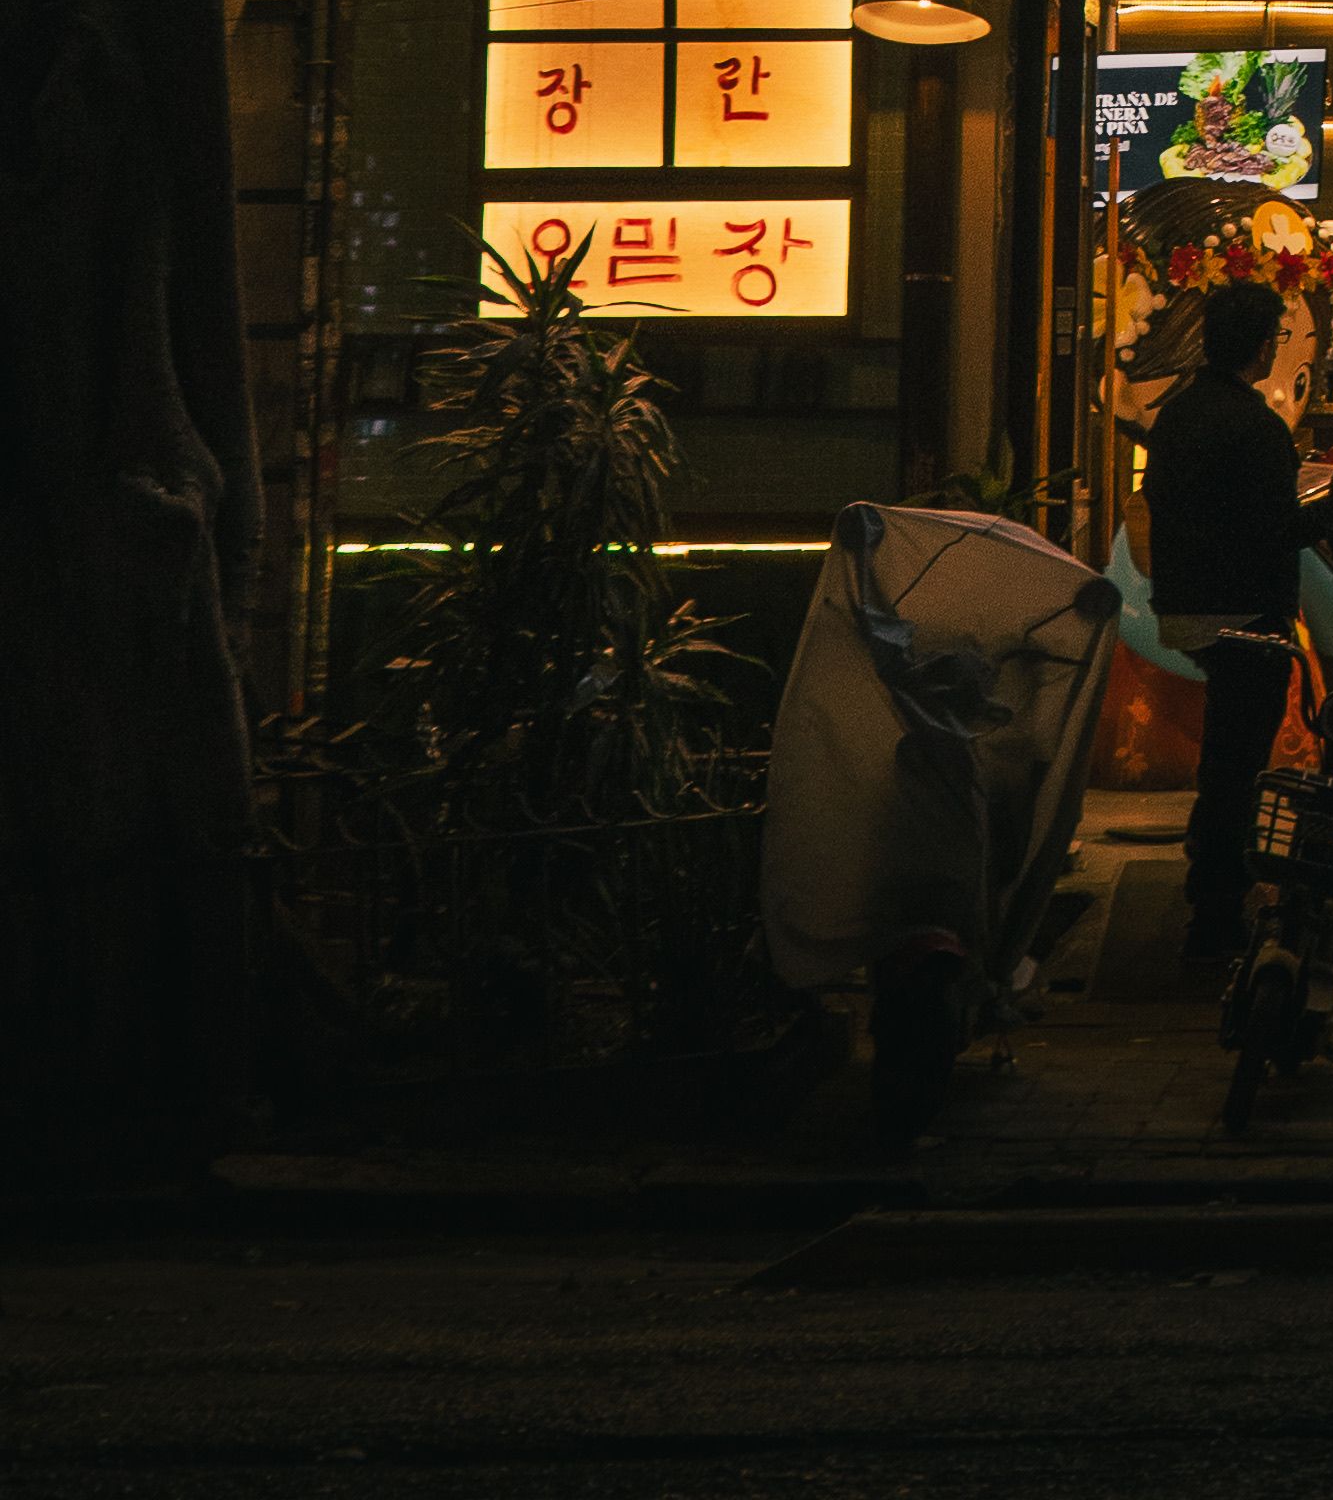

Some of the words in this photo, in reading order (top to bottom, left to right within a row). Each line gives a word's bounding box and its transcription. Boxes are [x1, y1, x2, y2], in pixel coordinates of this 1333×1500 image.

[536, 62, 593, 136] 장
[713, 54, 771, 122] 란
[1153, 91, 1179, 106] DE
